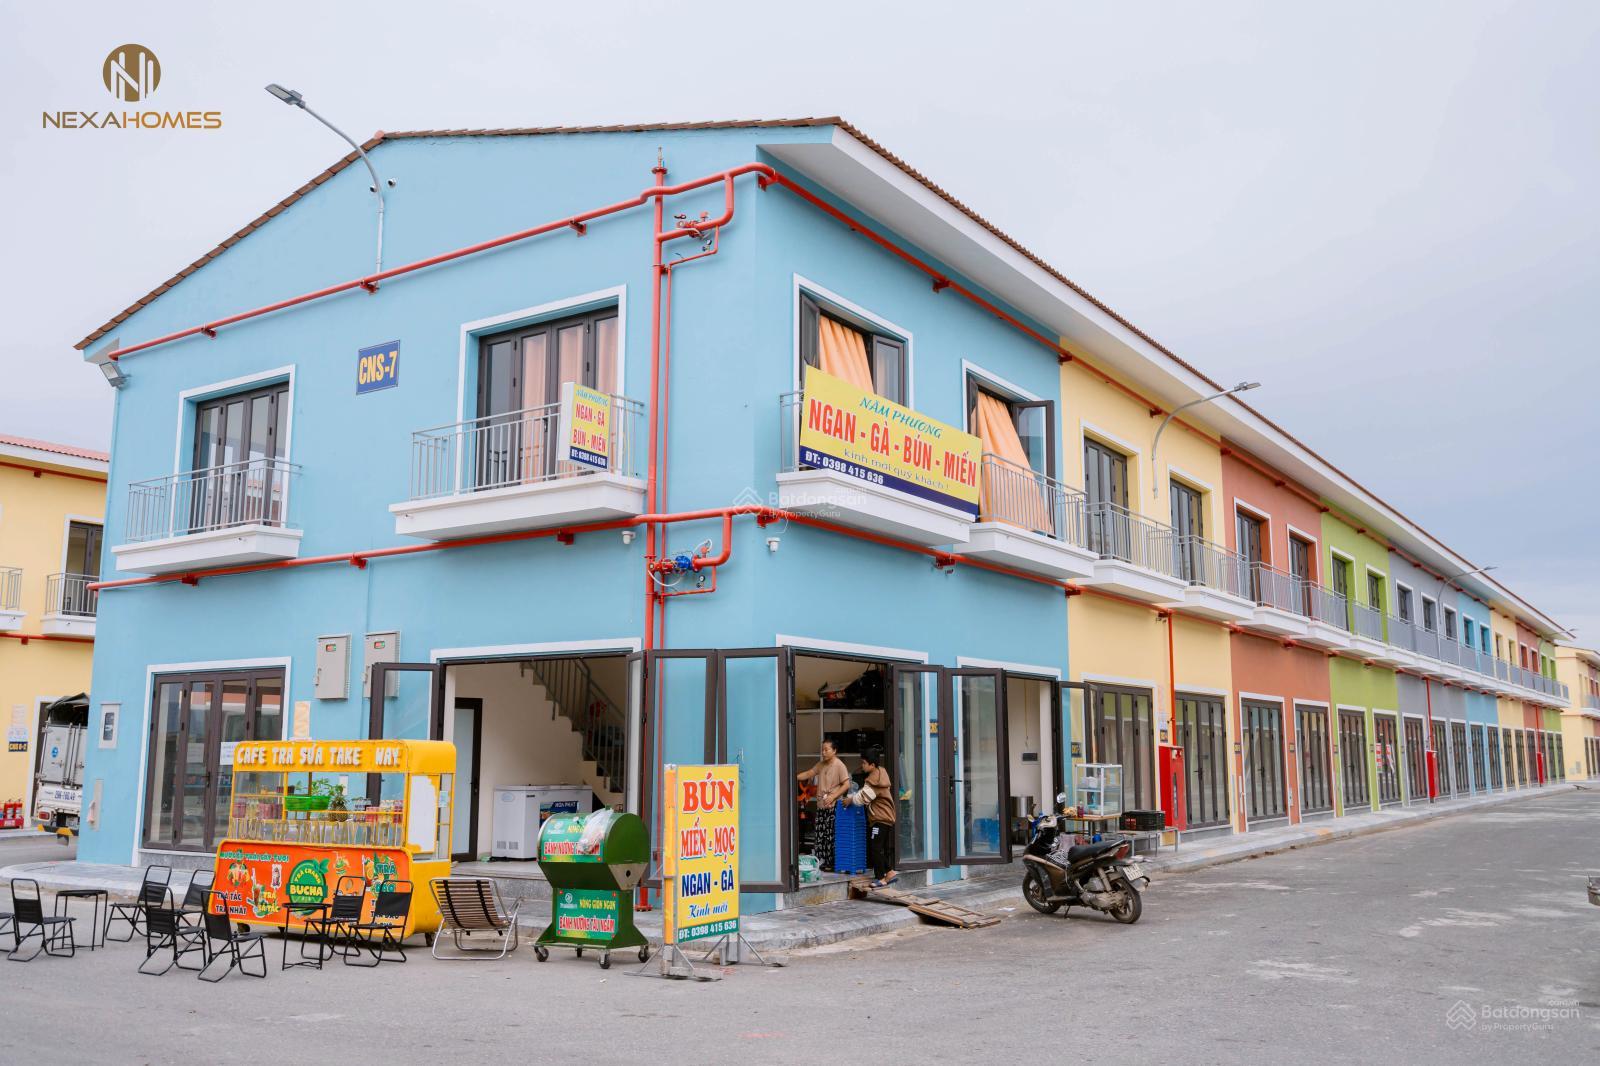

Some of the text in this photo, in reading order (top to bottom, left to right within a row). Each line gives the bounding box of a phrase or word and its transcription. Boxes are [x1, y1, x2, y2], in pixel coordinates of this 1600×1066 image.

[359, 351, 397, 384] CNS-7
[575, 403, 593, 422] NGAN
[808, 399, 857, 443] NGAN
[870, 421, 890, 456] GÀ
[903, 434, 932, 471] BÚN
[943, 451, 976, 487] MIẾN
[805, 450, 884, 485] ĐT: 0398 415 636
[329, 747, 361, 766] TAKE
[683, 772, 735, 813] BÚN
[714, 827, 736, 862] MỌC
[290, 884, 324, 897] BUCHA
[681, 871, 711, 898] NGAN
[721, 865, 734, 892] GÀ
[691, 924, 709, 937] 0398
[710, 922, 723, 933] 415
